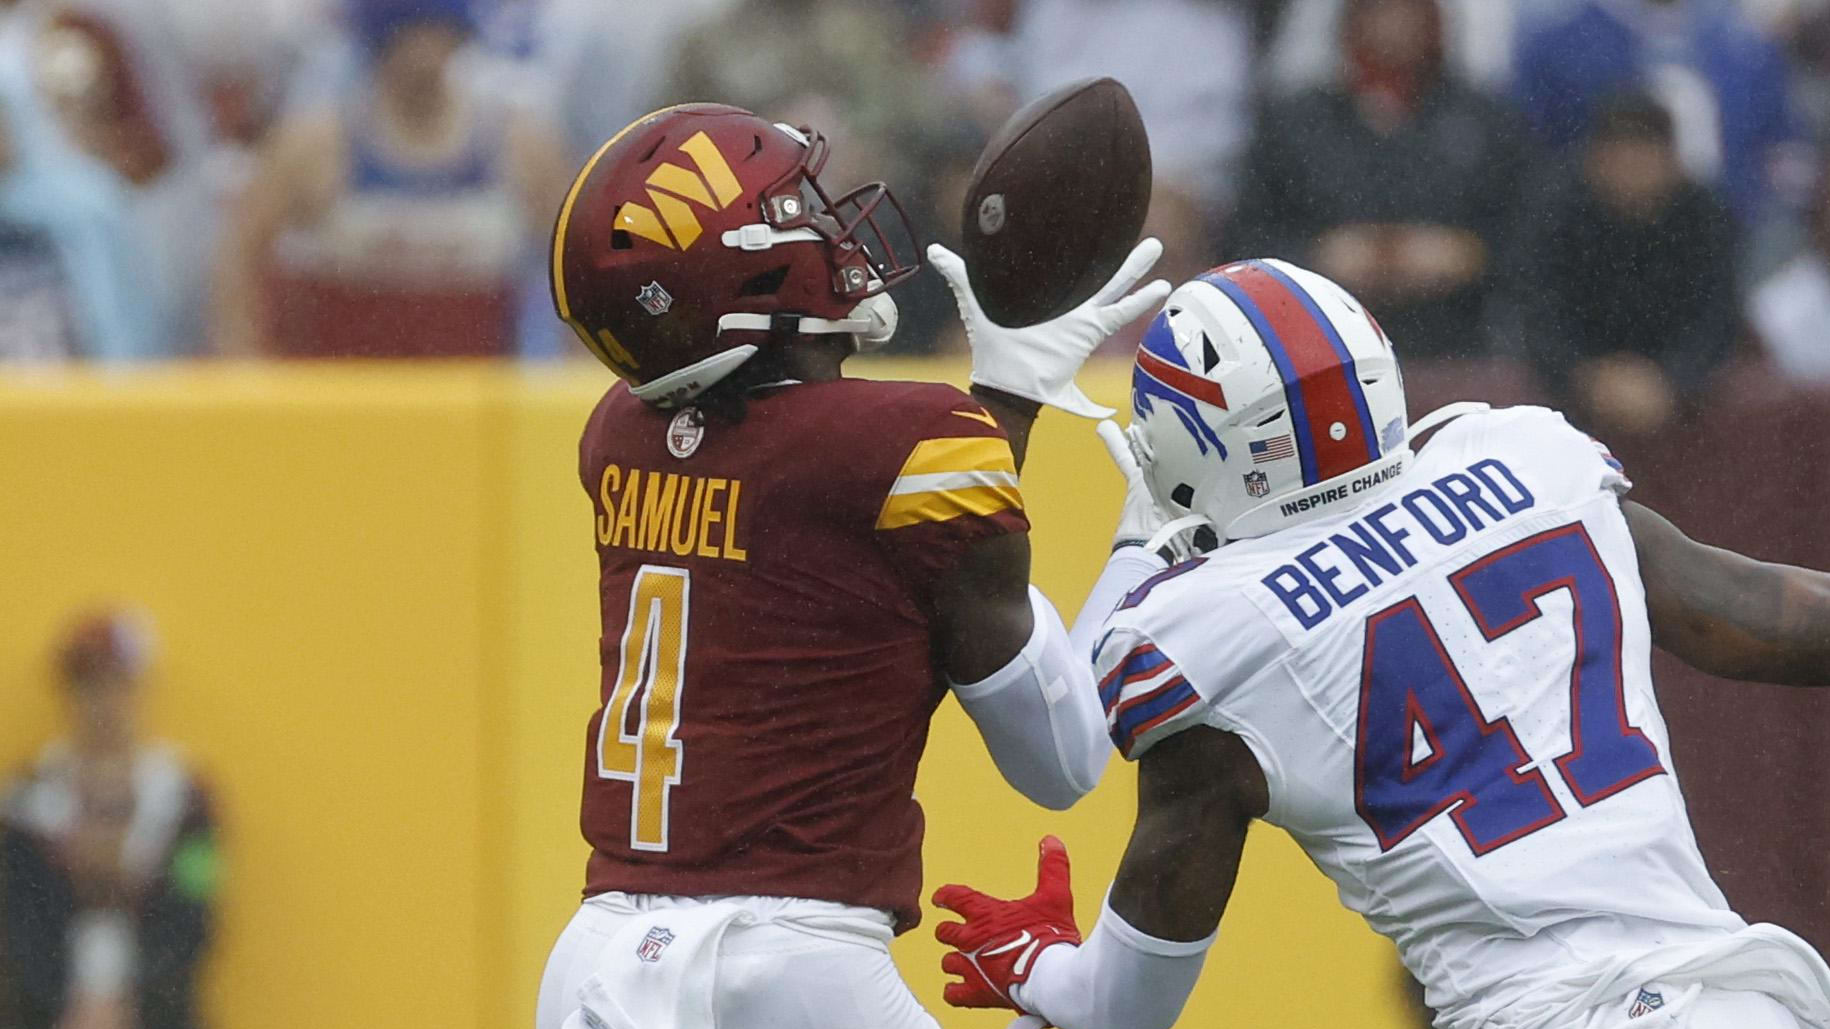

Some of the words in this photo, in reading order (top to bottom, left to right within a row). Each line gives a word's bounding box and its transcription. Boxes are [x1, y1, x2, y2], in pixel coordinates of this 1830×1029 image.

[597, 463, 747, 562] SAMUEL
[1260, 457, 1536, 632] BENFORD
[1280, 484, 1349, 517] INSPIRE
[1351, 461, 1403, 494] CHANGE
[597, 563, 691, 852] 4
[1353, 519, 1669, 858] 47
